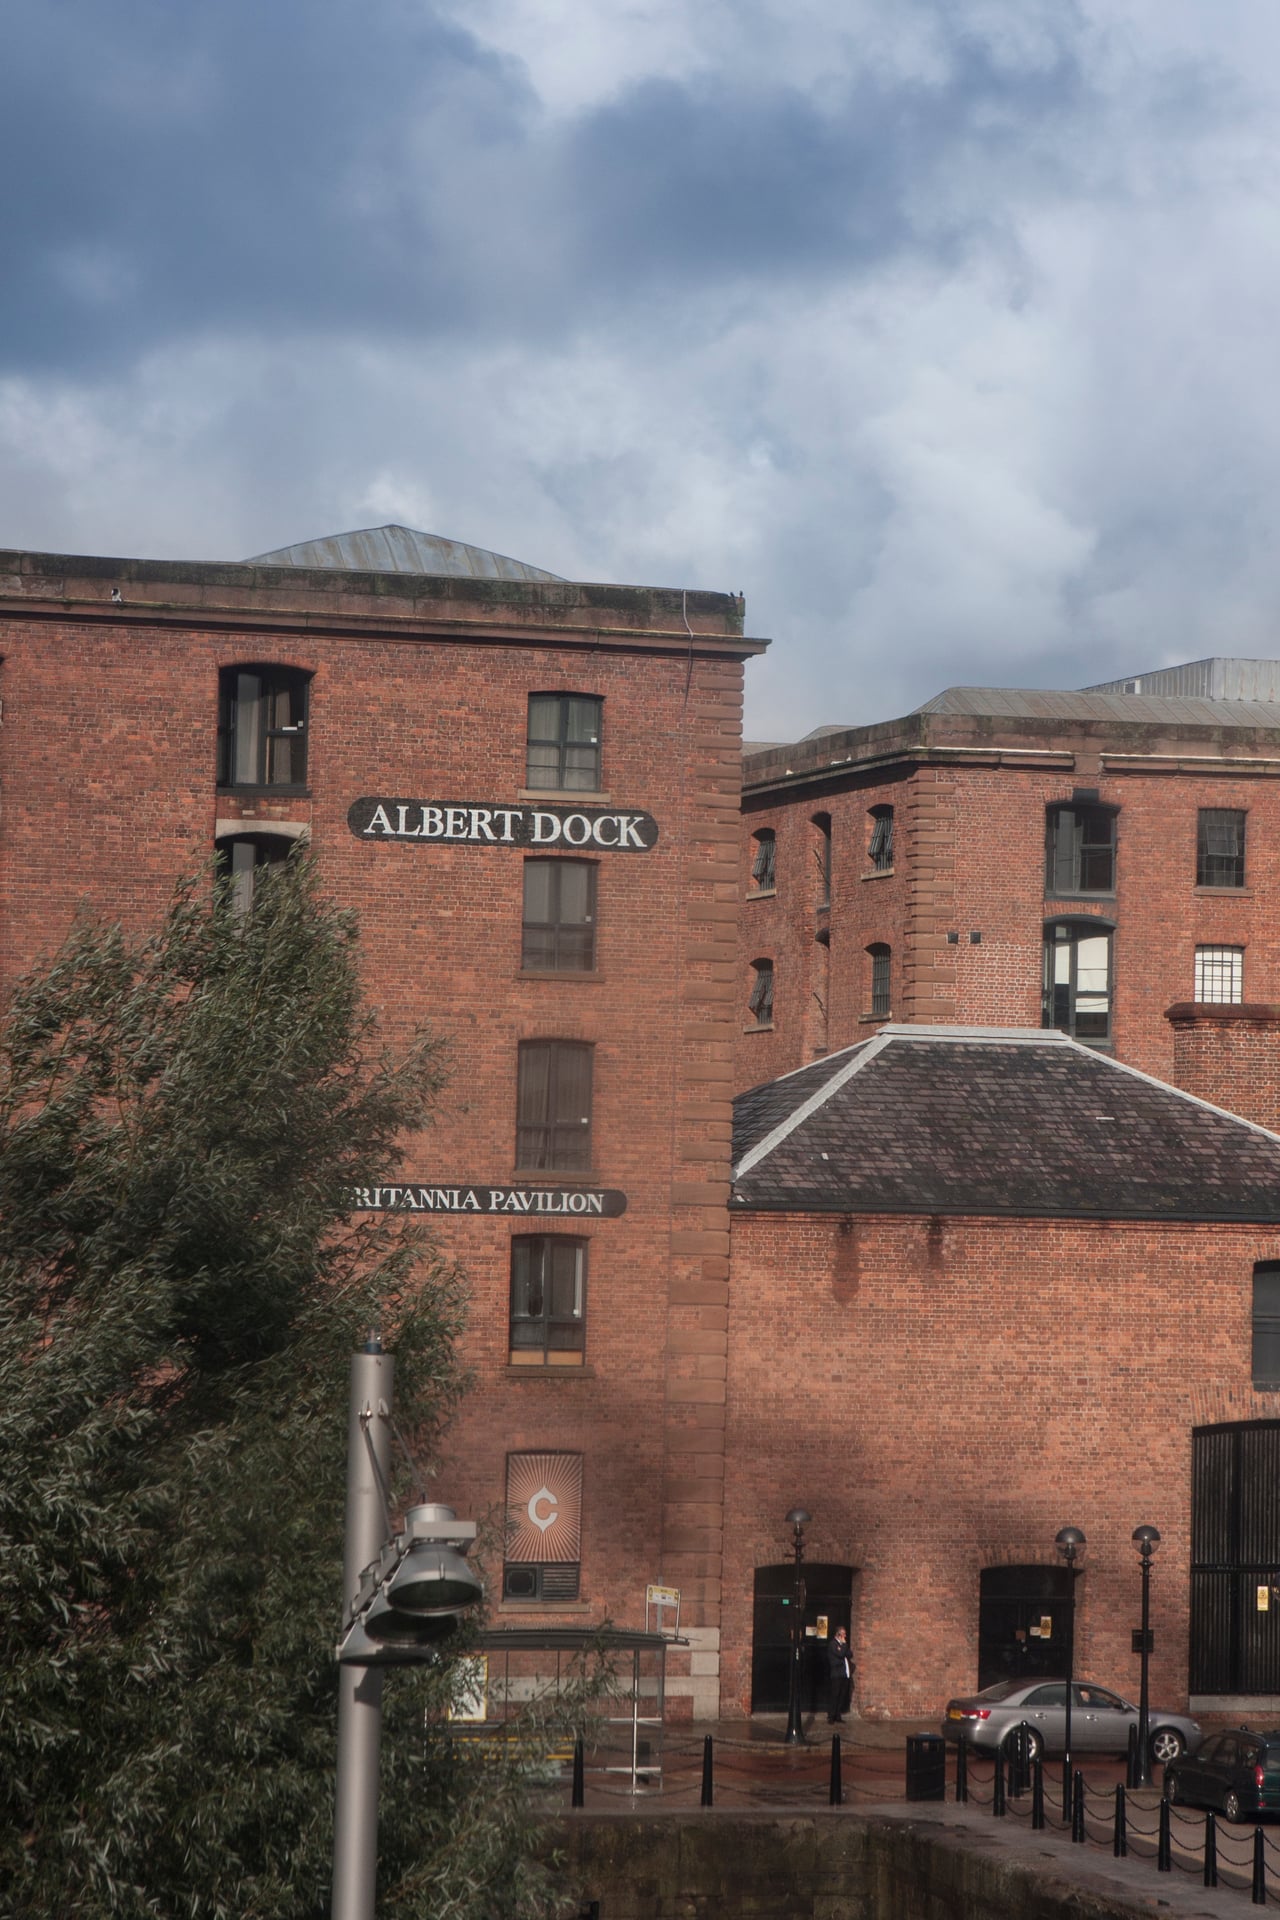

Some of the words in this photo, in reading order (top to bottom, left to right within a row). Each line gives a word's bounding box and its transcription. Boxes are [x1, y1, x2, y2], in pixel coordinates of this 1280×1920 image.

[363, 804, 523, 841] ALBERT
[530, 811, 648, 848] DOCK
[339, 1186, 482, 1210] RITANNIA
[488, 1189, 605, 1213] PAVILION
